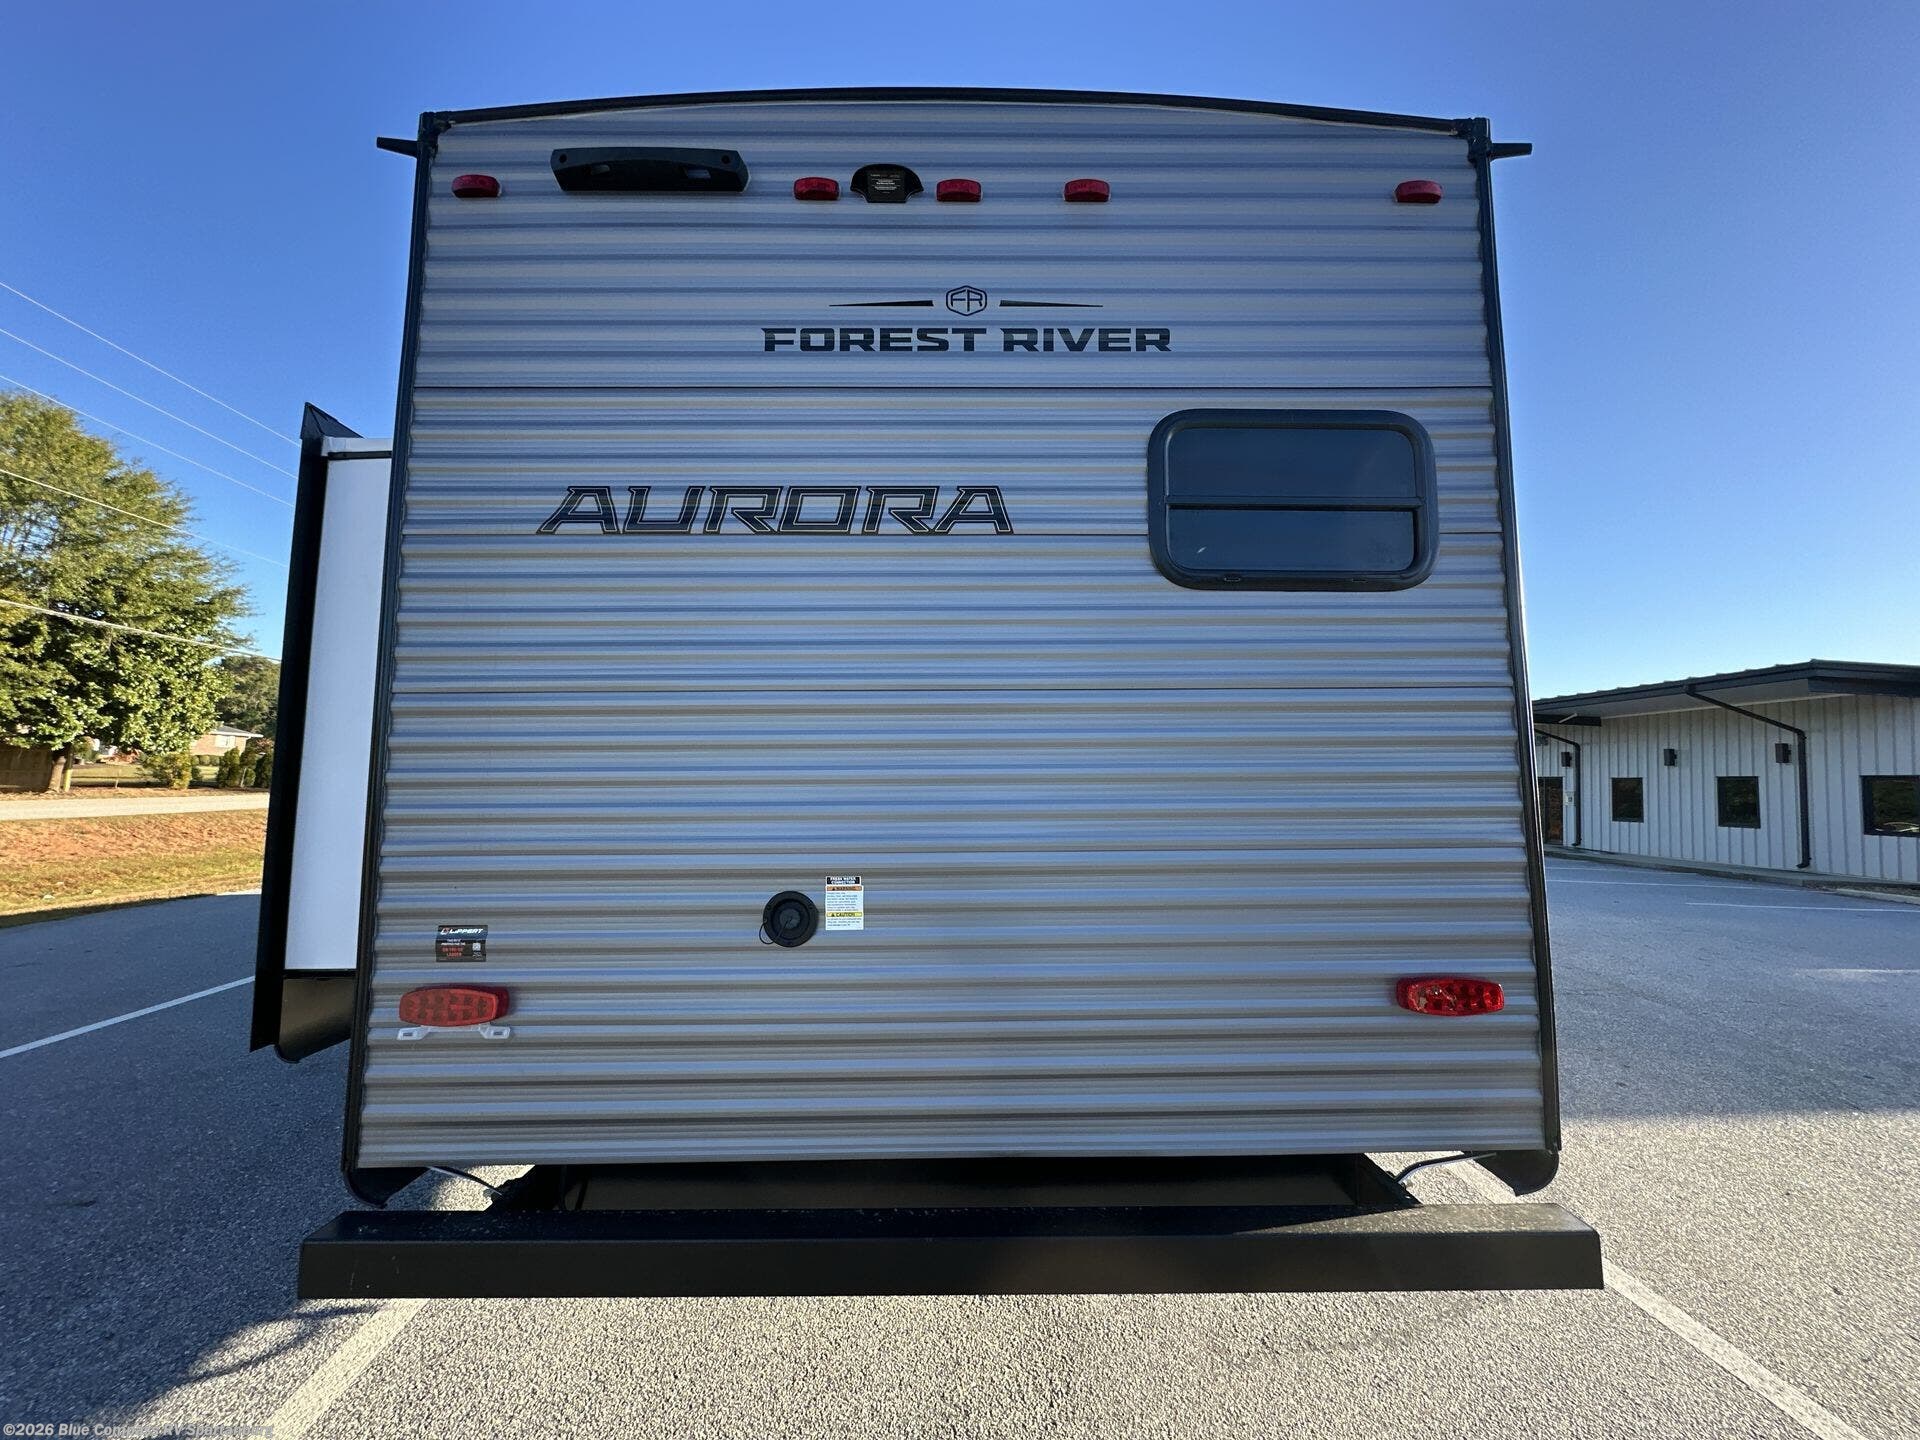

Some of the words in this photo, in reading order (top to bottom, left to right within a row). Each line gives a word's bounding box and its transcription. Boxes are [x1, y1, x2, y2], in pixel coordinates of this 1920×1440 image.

[760, 327, 988, 352] FOREST
[999, 327, 1172, 352] RIVER
[535, 485, 1015, 535] AURORA
